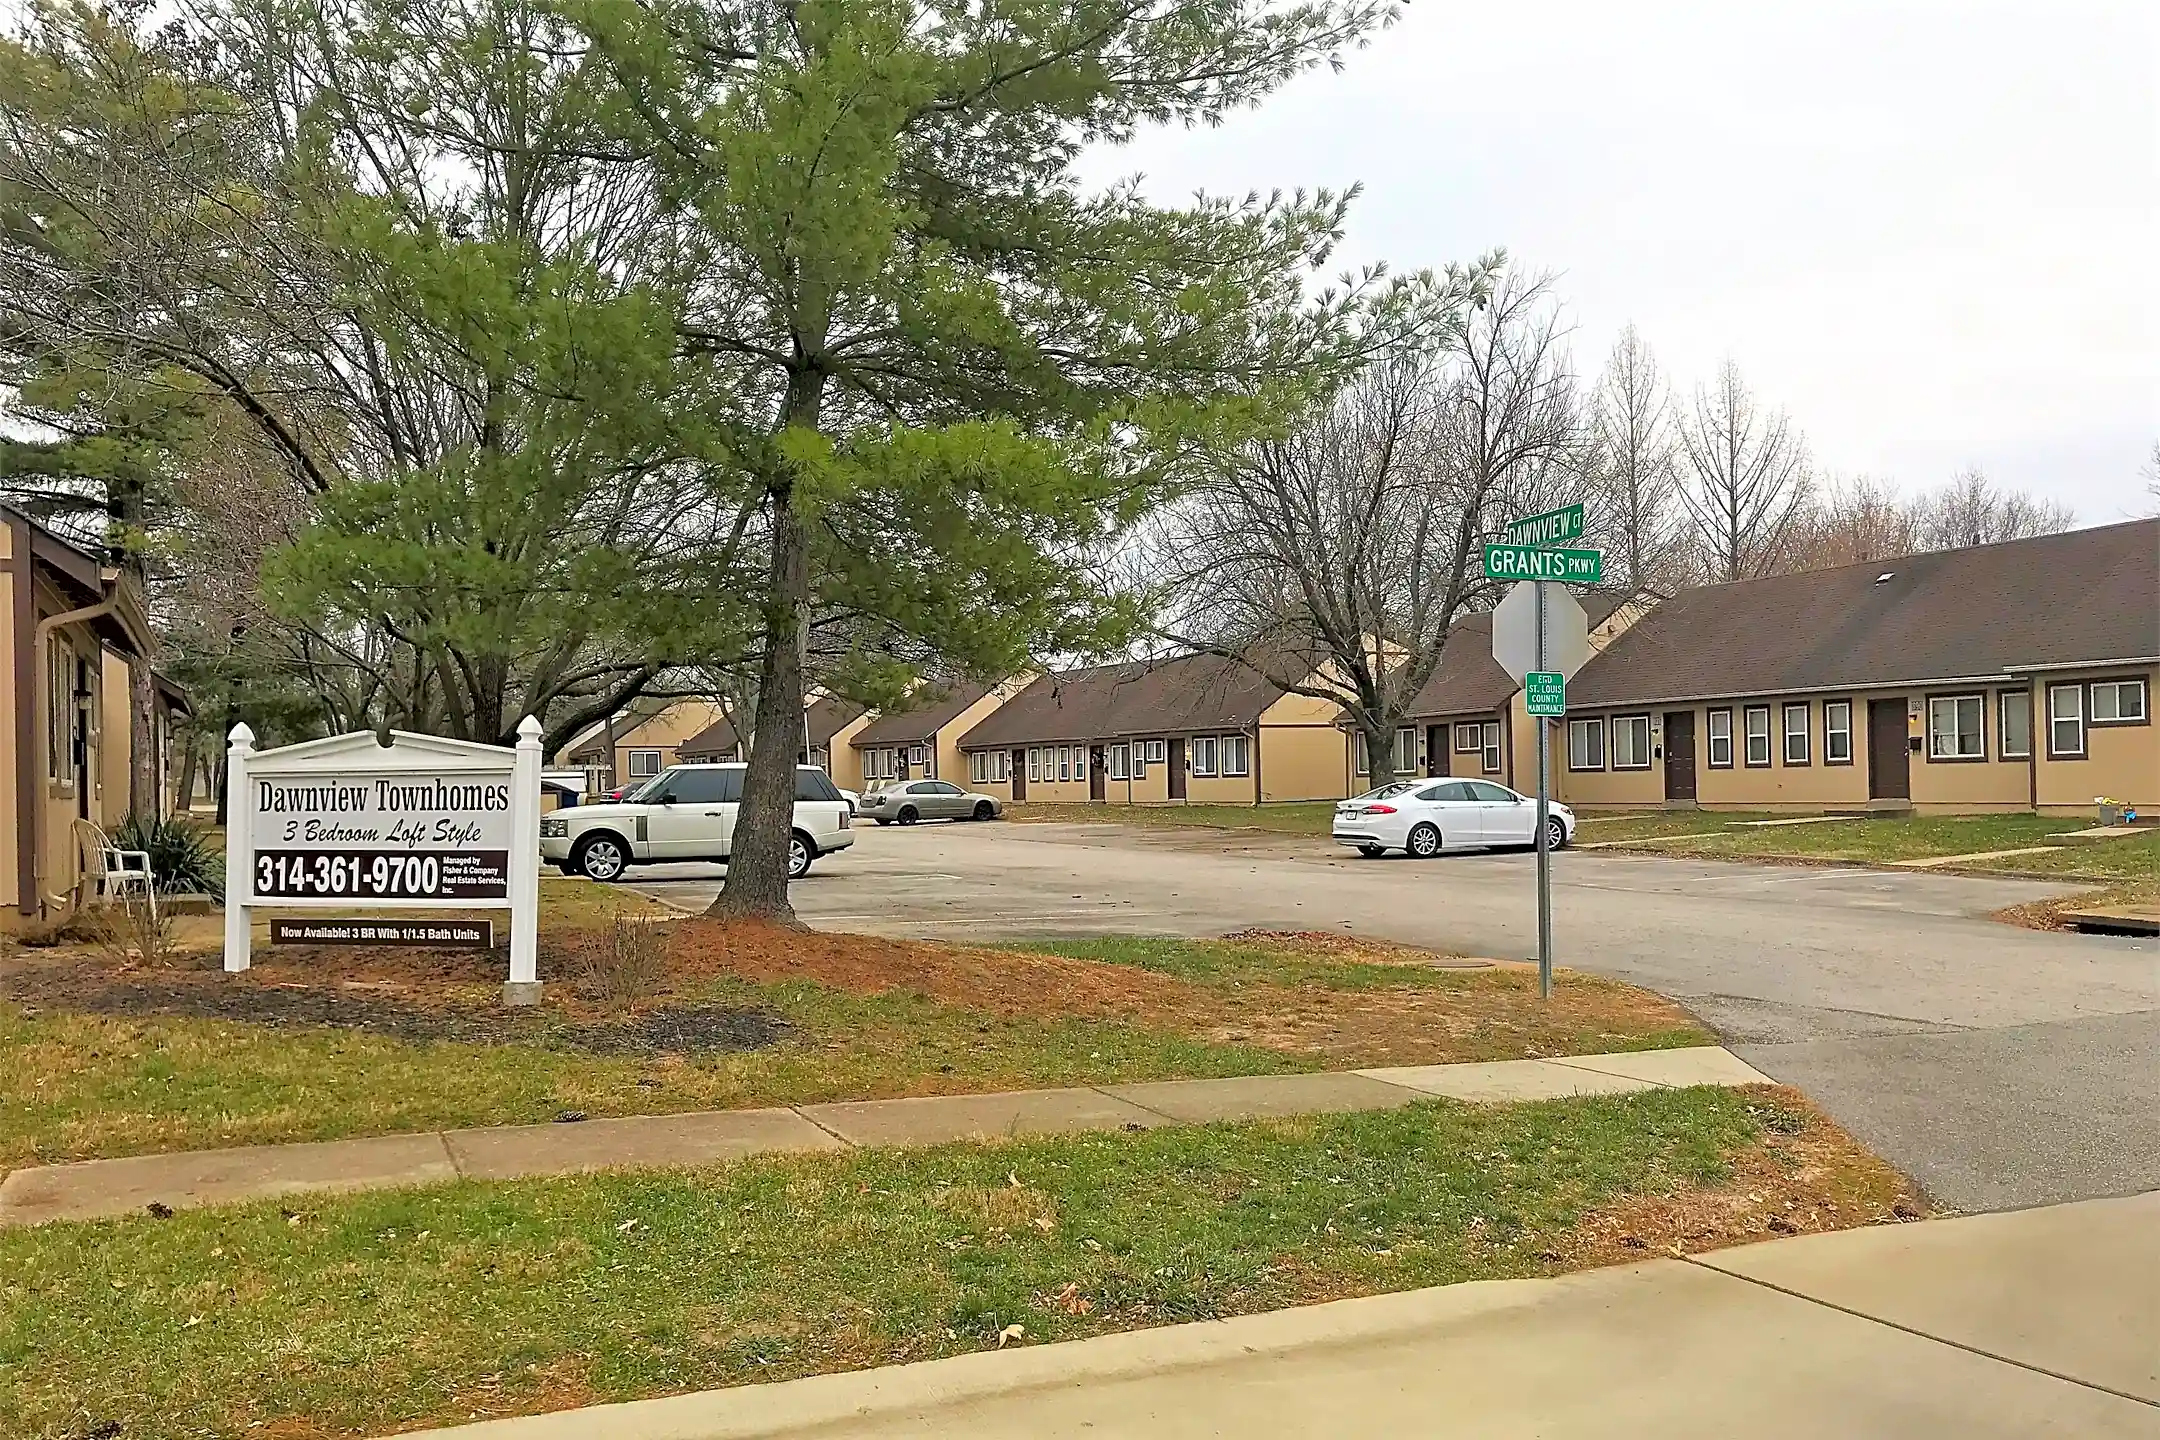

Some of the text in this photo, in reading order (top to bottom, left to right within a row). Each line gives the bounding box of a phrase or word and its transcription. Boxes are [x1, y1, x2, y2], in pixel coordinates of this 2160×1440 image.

[1508, 512, 1582, 545] DAWNVIEW CT
[1490, 549, 1595, 576] GRANTS PKWY
[1529, 685, 1562, 694] ST. LOUIS
[1531, 694, 1559, 703] COUNTY
[259, 778, 508, 812] Dawnview Townhomes
[283, 818, 482, 848] 3 Bedroom Loft Style
[443, 856, 480, 866] Managed by
[257, 855, 438, 894] 314-361-9700
[443, 866, 498, 876] Fisher & Company
[442, 876, 506, 885] Real Estate Services,
[442, 886, 454, 894] Inc.
[281, 926, 480, 941] Now Available! 3 BR With 1/1.5 Bath Units
